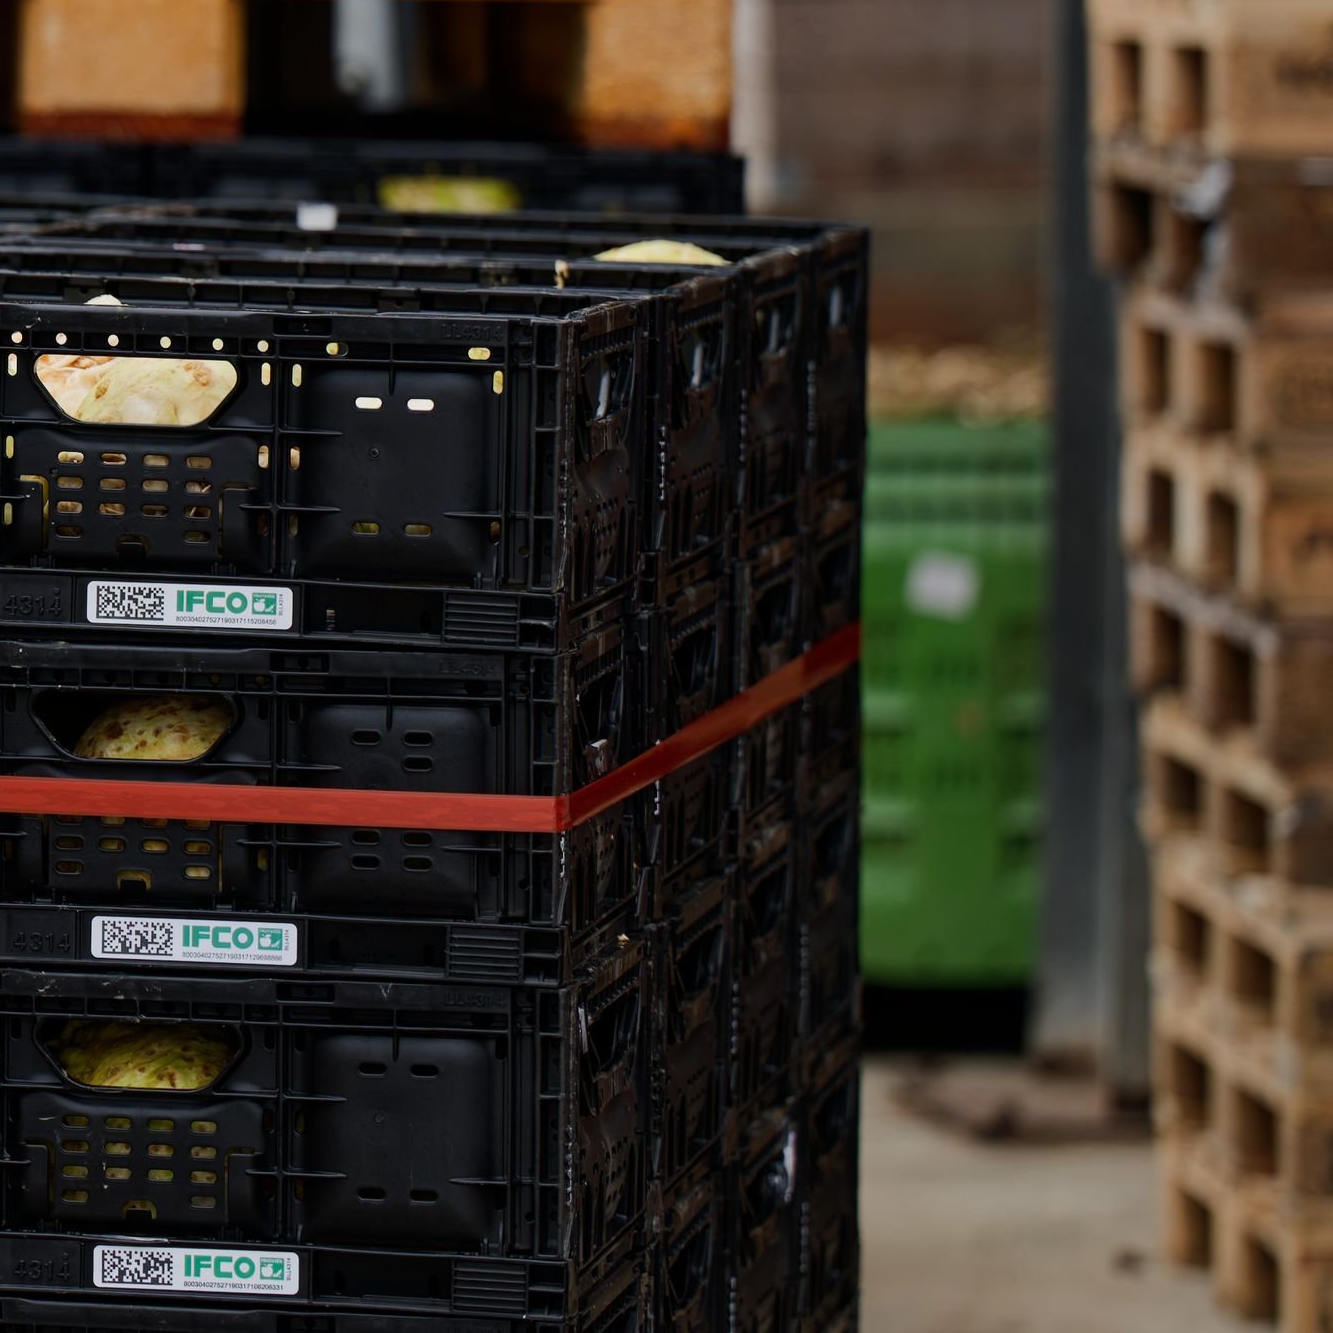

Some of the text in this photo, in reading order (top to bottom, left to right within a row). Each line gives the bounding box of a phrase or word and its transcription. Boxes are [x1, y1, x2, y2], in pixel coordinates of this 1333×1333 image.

[176, 590, 248, 614] IFCO
[13, 931, 71, 955] 4314
[182, 925, 254, 949] IFCO
[184, 1255, 256, 1279] IFCO
